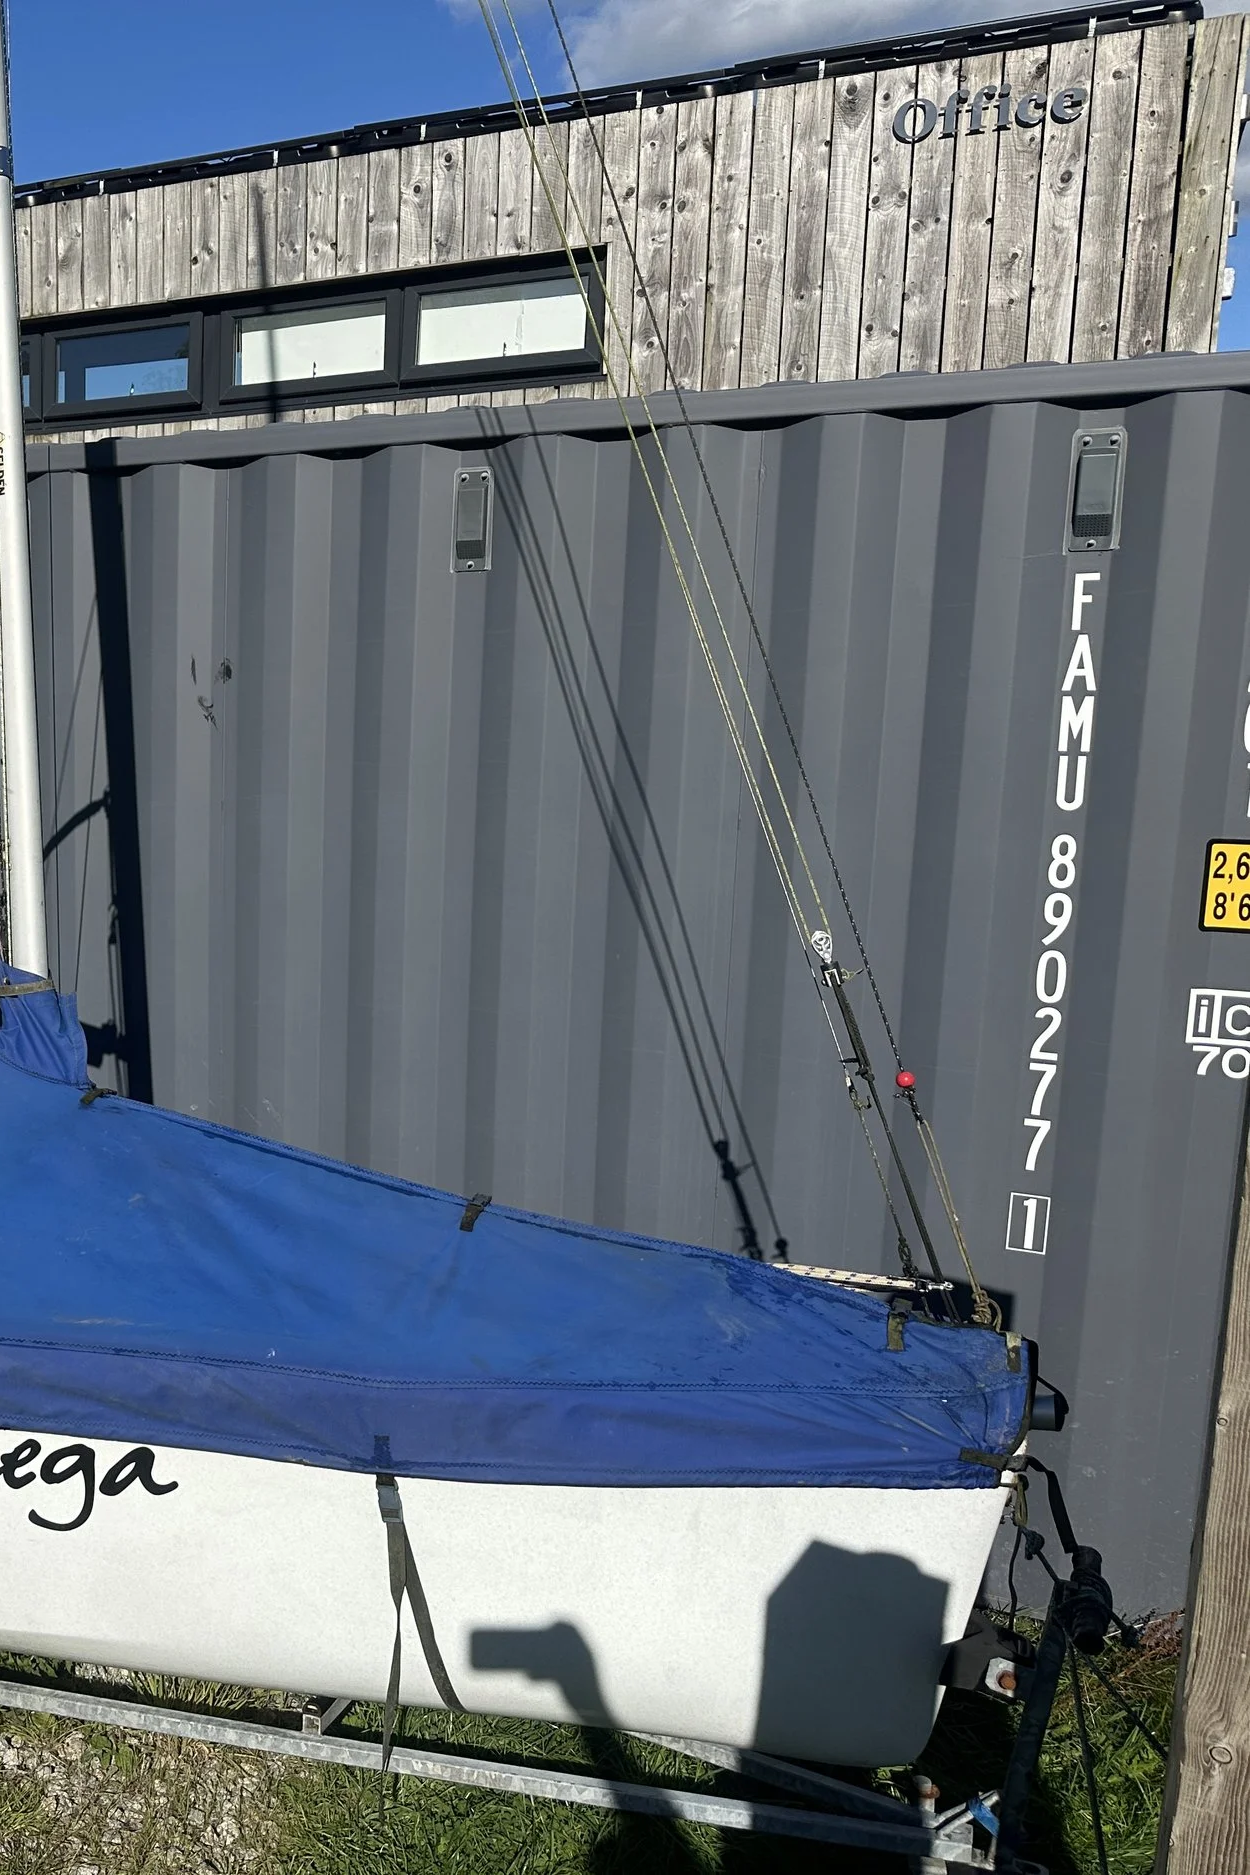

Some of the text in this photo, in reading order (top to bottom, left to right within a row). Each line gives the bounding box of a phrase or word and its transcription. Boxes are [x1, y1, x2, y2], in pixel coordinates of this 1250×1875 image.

[893, 83, 1088, 143] Office
[1023, 572, 1101, 1250] FAMU 890277 1
[1192, 1045, 1250, 1079] 70
